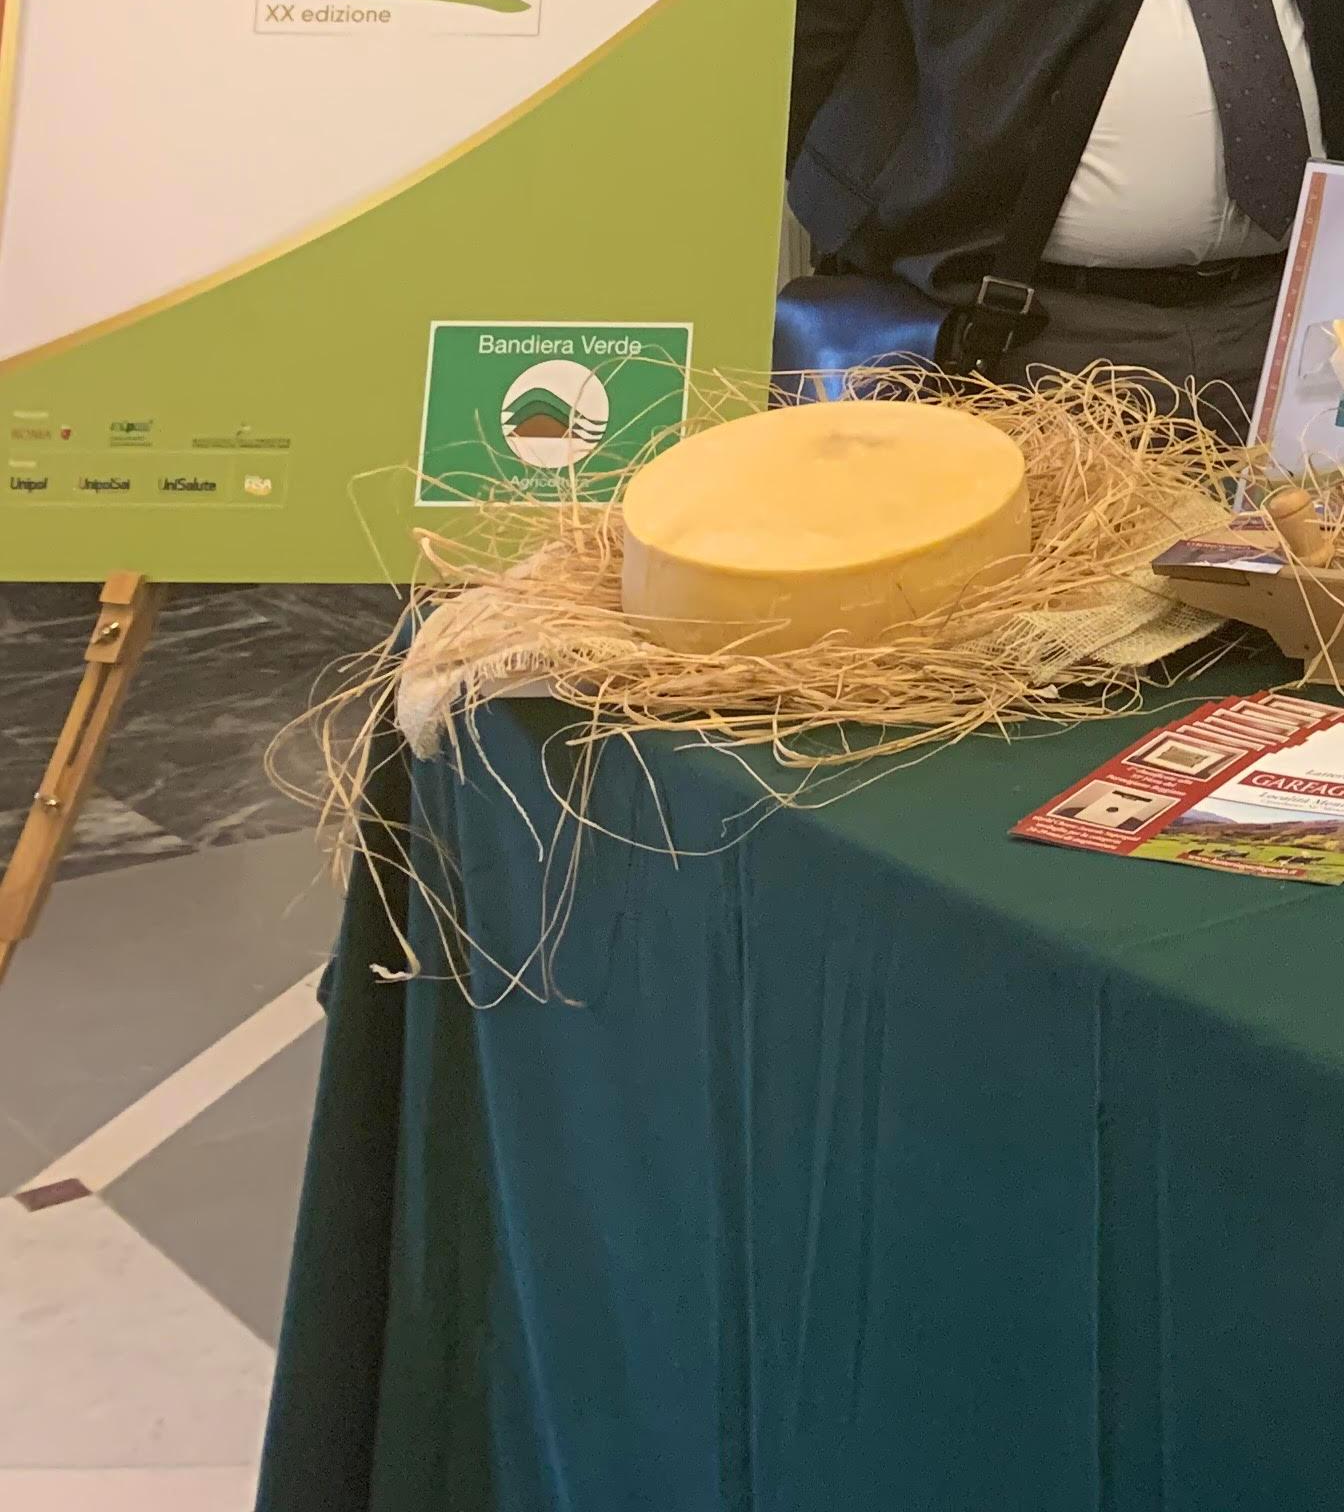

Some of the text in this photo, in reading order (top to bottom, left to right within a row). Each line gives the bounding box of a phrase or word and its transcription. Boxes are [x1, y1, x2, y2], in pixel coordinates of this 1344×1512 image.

[265, 4, 391, 23] XX edizione
[478, 334, 642, 355] Bandiera Verde
[10, 477, 48, 493] Unipol
[157, 477, 216, 492] UniSalute
